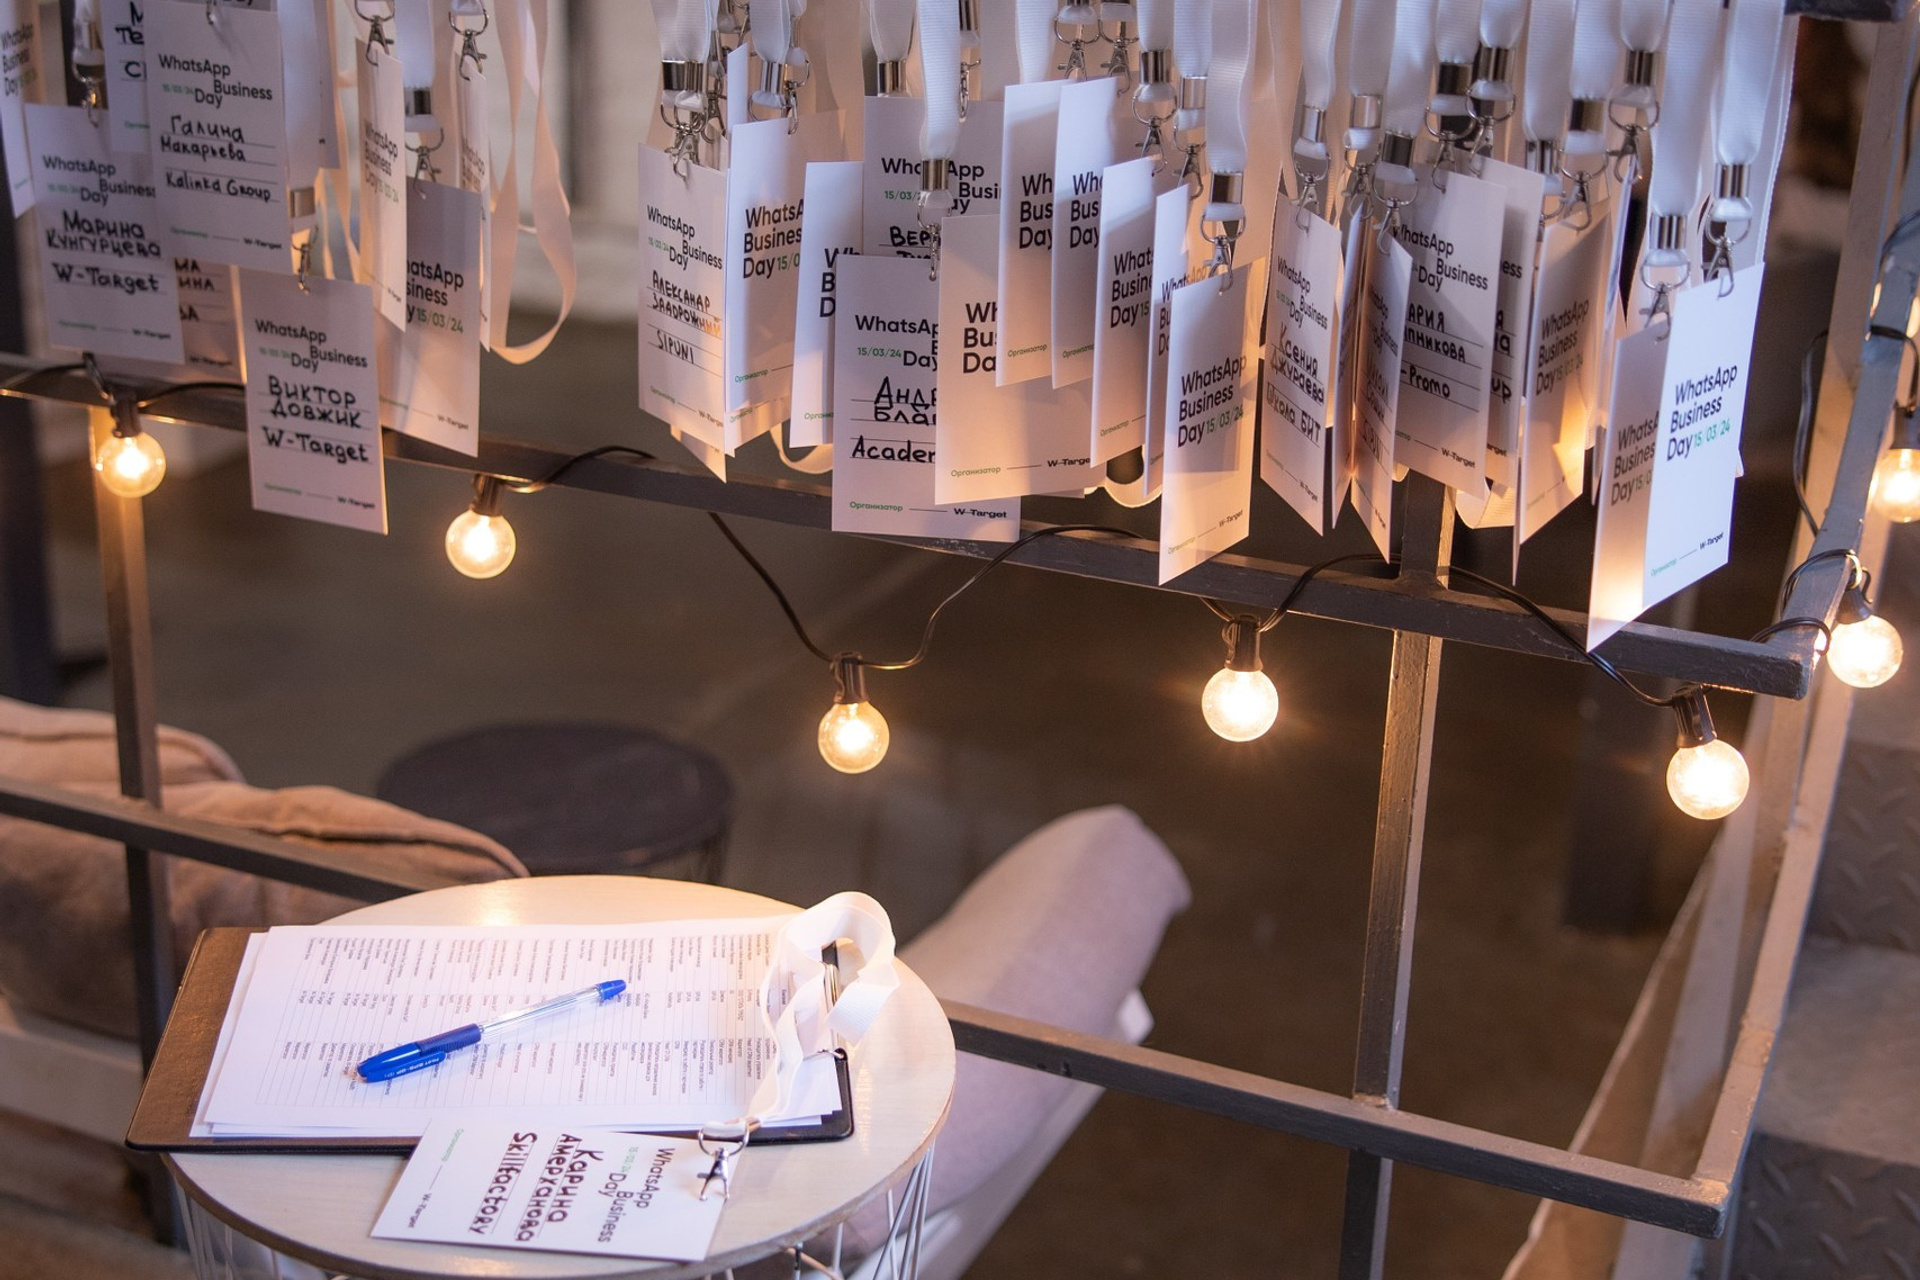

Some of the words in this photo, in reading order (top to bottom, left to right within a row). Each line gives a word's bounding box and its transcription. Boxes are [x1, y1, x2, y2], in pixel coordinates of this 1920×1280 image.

[158, 54, 231, 78] WhatsApp
[195, 88, 223, 109] Day
[213, 79, 273, 100] Business
[171, 115, 244, 143] Галина
[43, 155, 117, 177] WhatsApp
[365, 140, 392, 176] Business
[166, 171, 221, 193] Kalinka
[958, 183, 1001, 200] Busi
[1022, 173, 1053, 196] Wh
[80, 187, 109, 207] Day
[951, 199, 971, 215] ay
[1070, 200, 1099, 222] Bus
[63, 210, 145, 240] Марина
[647, 205, 695, 240] WhatsApp
[1020, 201, 1053, 223] Bus
[1069, 226, 1099, 249] Day
[669, 247, 688, 271] Day
[682, 240, 723, 270] Business
[743, 257, 775, 279] Day
[52, 262, 159, 295] W-Target
[1277, 255, 1311, 294] WhatsApp
[1418, 266, 1443, 292] Day
[1436, 258, 1488, 290] Business
[416, 307, 464, 333] 15/03/24
[1110, 303, 1139, 328] Day
[1289, 303, 1304, 329] Day
[1300, 295, 1328, 330] Business
[1542, 299, 1590, 340] WhatsApp
[255, 319, 327, 344] WhatsApp
[310, 345, 368, 368] Business
[656, 330, 695, 364] SIPUNI
[857, 347, 901, 358] 15/03/24
[903, 350, 938, 372] Day
[1279, 322, 1318, 379] Ксения
[1538, 331, 1578, 368] Business
[291, 354, 319, 373] Day
[1181, 355, 1247, 396] WhatsApp
[268, 375, 356, 409] Виктор
[1536, 371, 1557, 397] Day
[1675, 364, 1738, 406] WhatsApp
[271, 398, 362, 429] Довжик
[1179, 384, 1234, 422] Business
[1670, 394, 1723, 433] Business
[1177, 421, 1205, 448] Day
[1206, 408, 1244, 433] 15/03/24
[1667, 433, 1694, 461] Day
[1693, 421, 1731, 449] 15/03/24
[261, 426, 369, 464] W-Target
[1441, 448, 1475, 468] W-Target
[1611, 475, 1635, 506] Day
[849, 501, 903, 513] Организатор
[953, 508, 1007, 519] W-Target
[1699, 531, 1725, 551] W-Target
[515, 1133, 582, 1242] Амерханова
[549, 1149, 604, 1223] Карина
[598, 1172, 627, 1198] Day
[636, 1147, 676, 1209] WhatsApp
[408, 1193, 432, 1229] W-Target
[597, 1190, 634, 1244] Business
